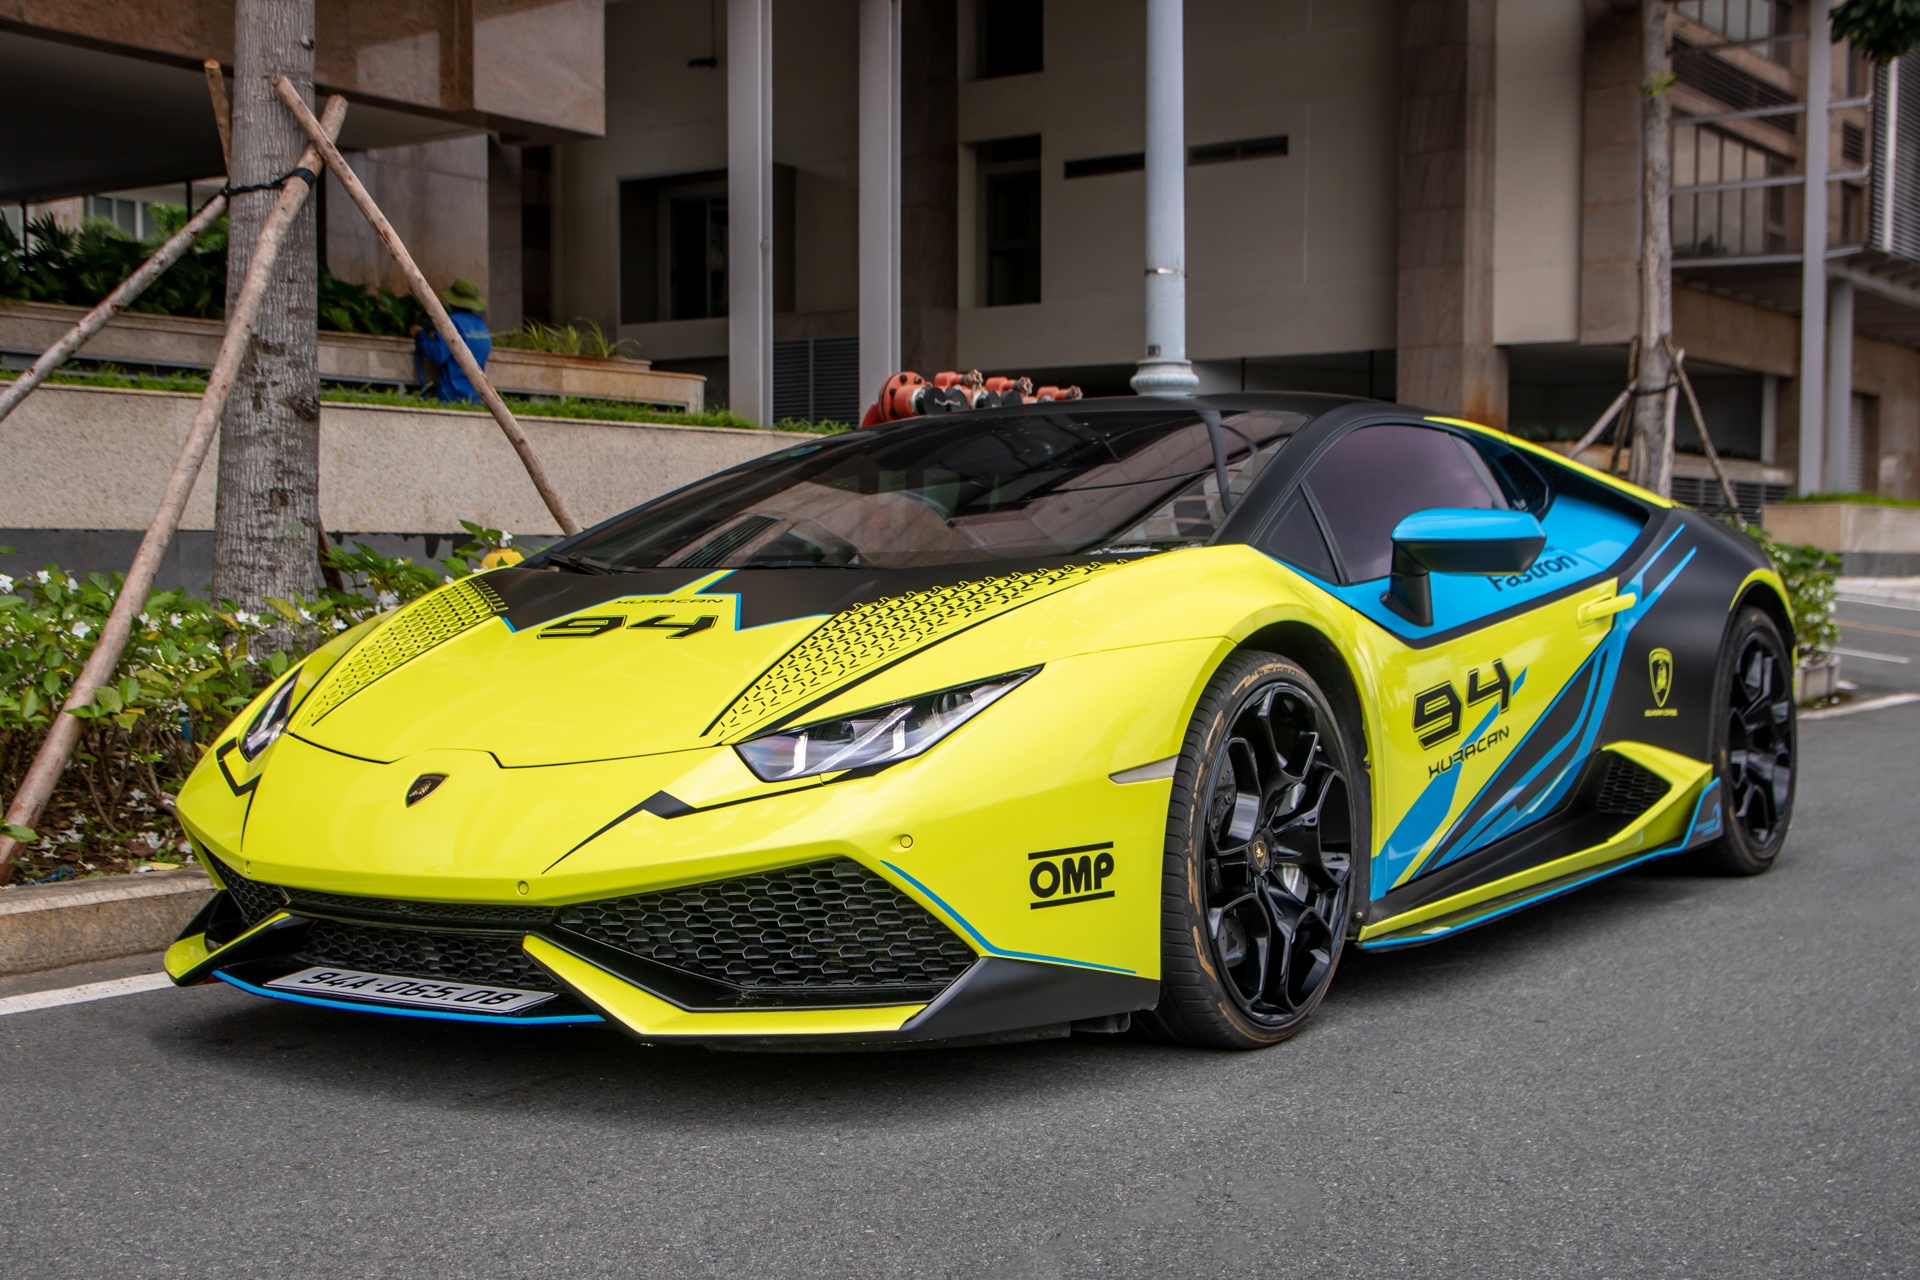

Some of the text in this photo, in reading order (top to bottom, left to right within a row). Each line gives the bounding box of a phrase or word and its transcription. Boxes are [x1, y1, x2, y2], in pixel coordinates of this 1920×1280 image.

[537, 615, 719, 639] 94
[1412, 658, 1512, 751] 94
[1428, 725, 1510, 779] HURACAN
[1029, 852, 1115, 898] OMP
